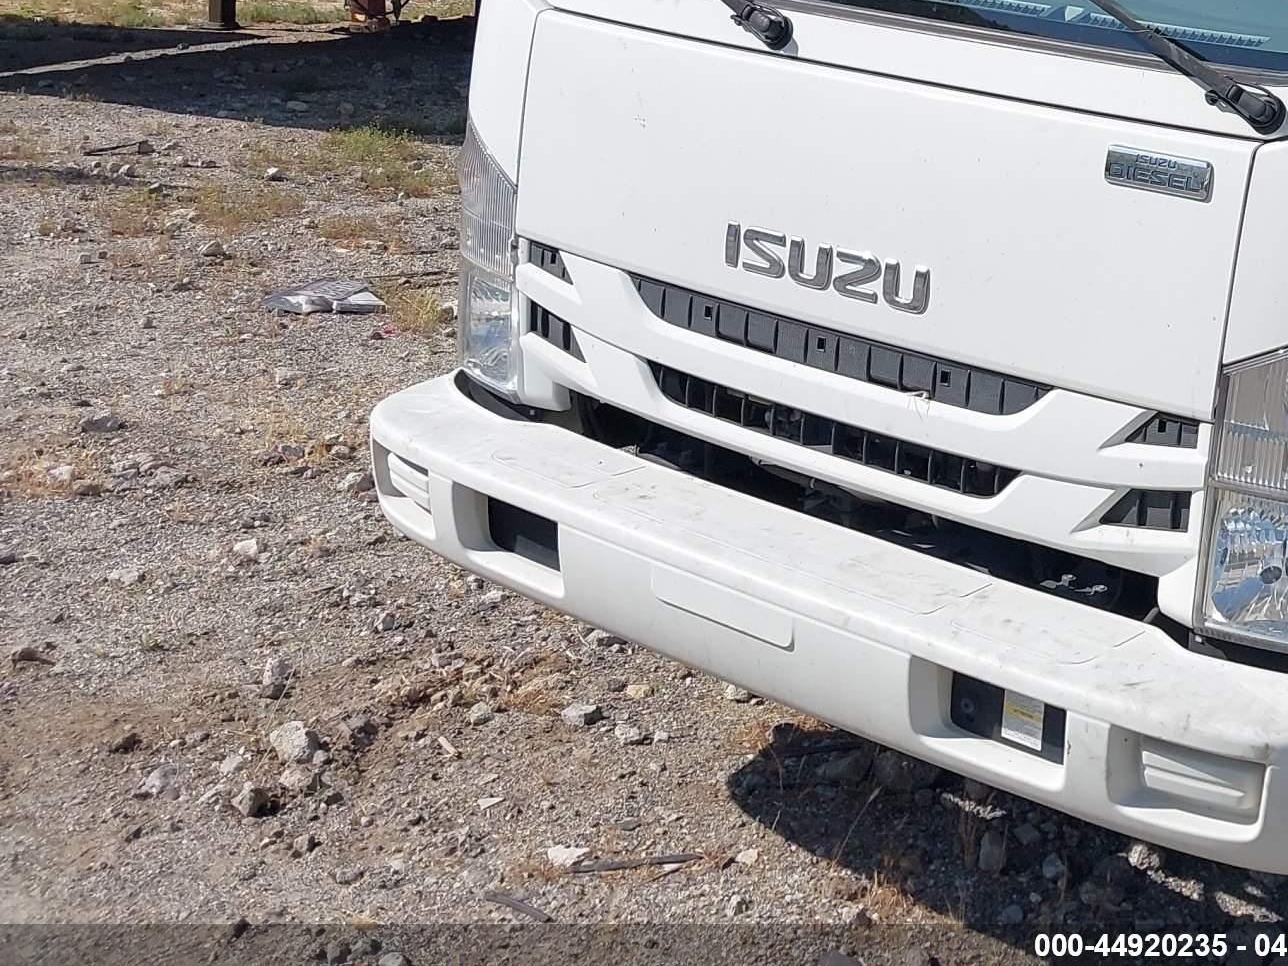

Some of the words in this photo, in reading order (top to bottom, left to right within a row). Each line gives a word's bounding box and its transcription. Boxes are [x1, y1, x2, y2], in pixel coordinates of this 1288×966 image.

[1136, 153, 1178, 169] ISUZU
[1108, 162, 1202, 193] DIESEL
[724, 220, 932, 315] ISUZU
